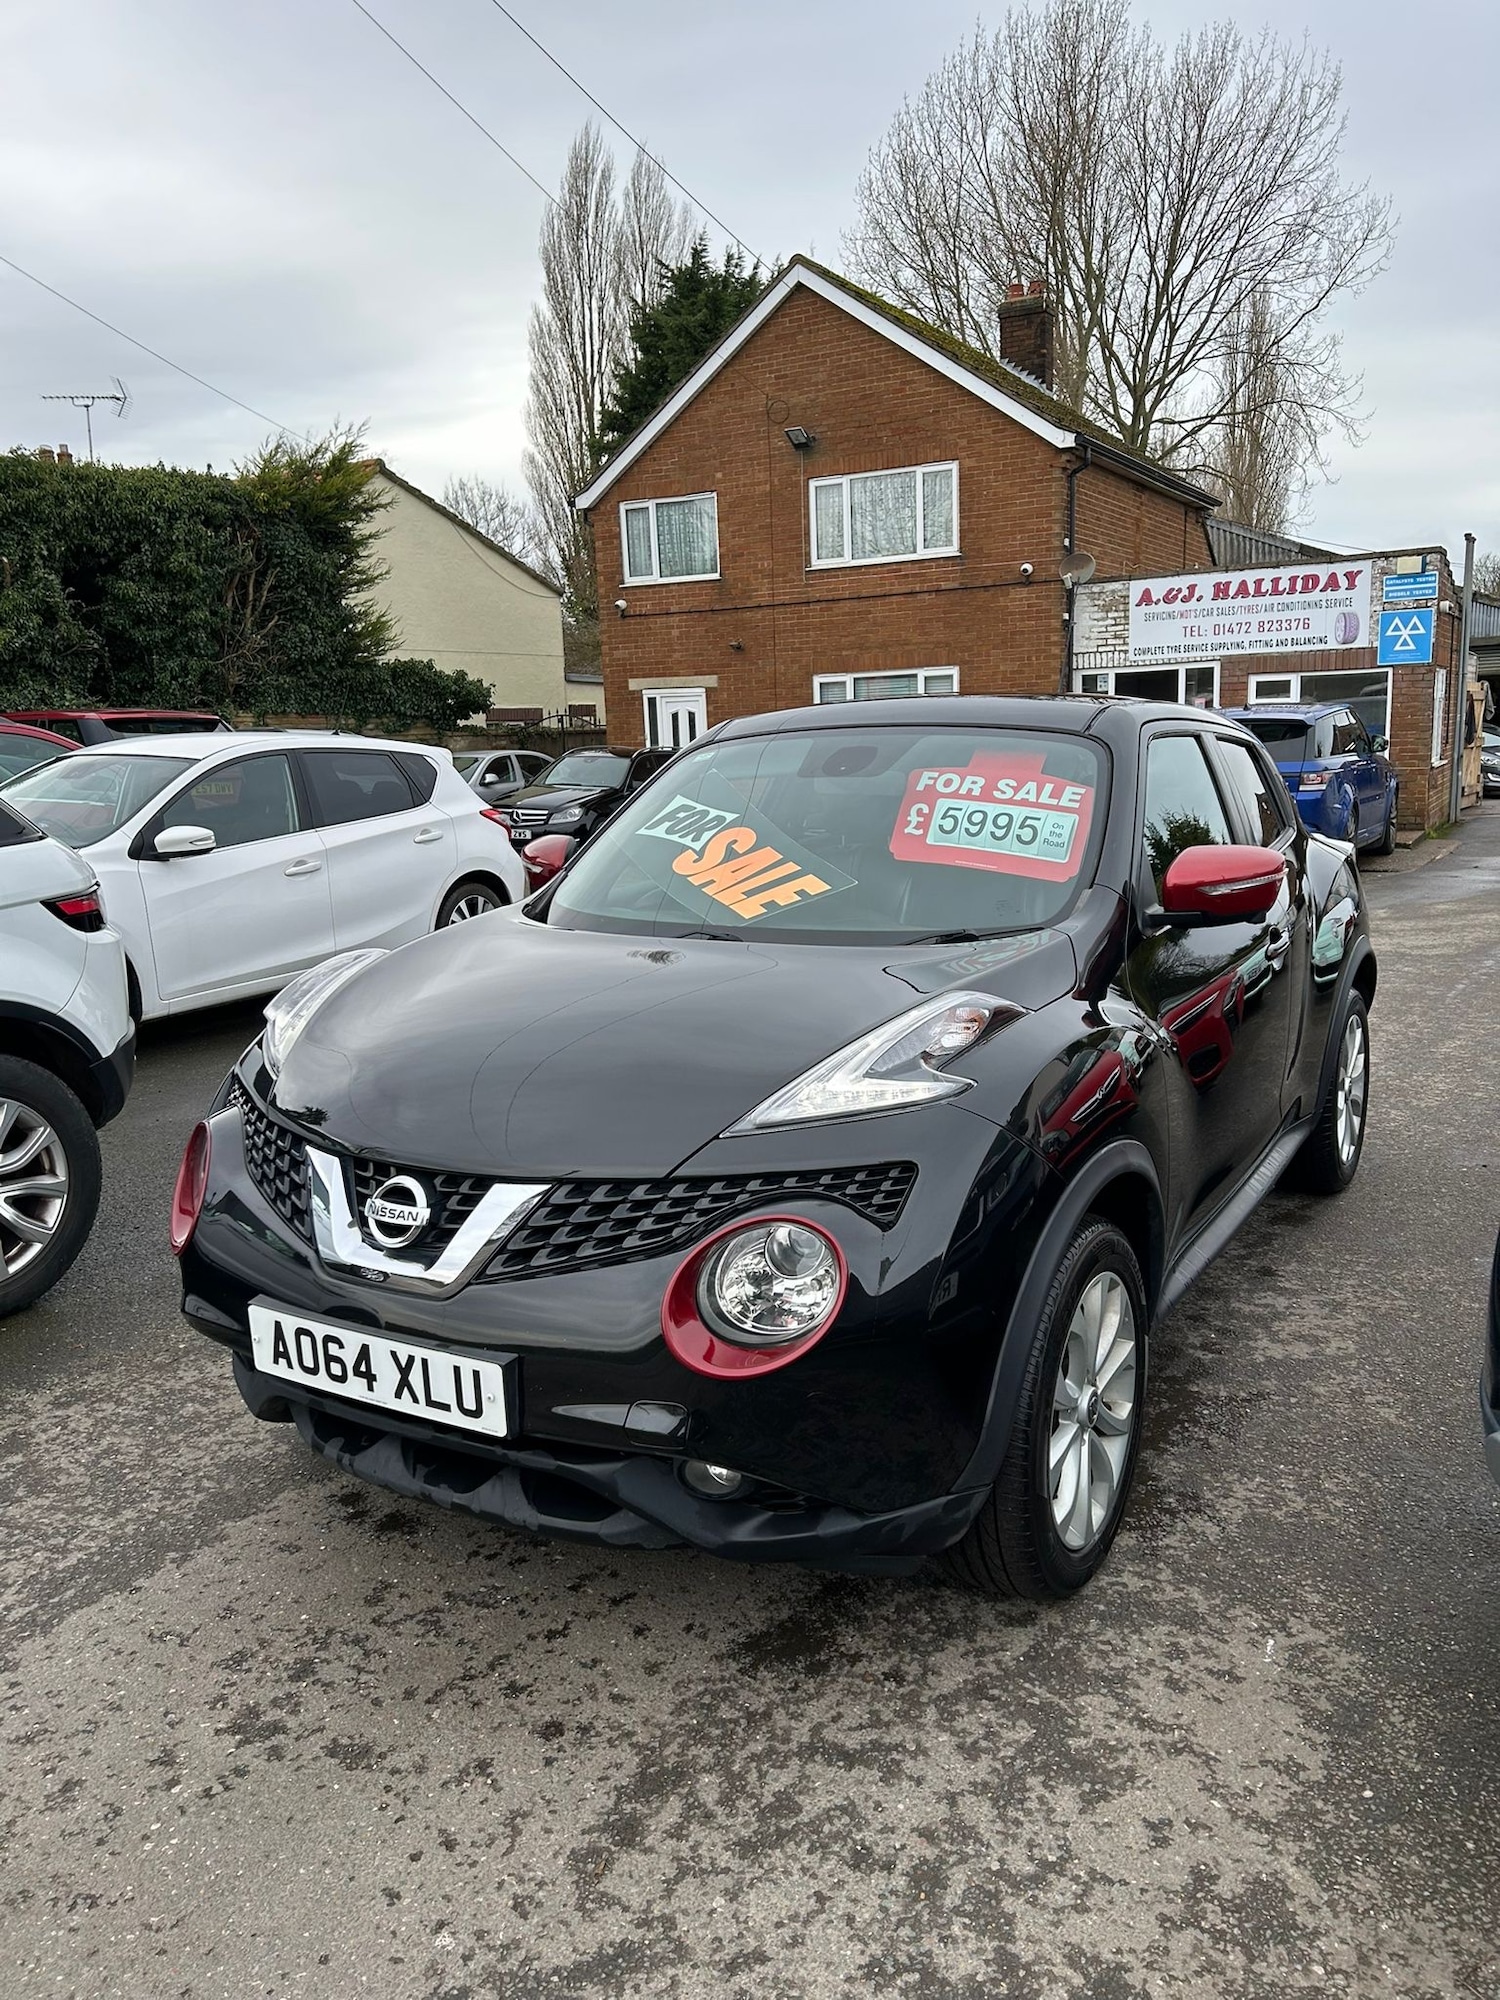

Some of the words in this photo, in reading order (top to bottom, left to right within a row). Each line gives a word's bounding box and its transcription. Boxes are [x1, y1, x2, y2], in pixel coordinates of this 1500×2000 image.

[1211, 570, 1363, 601] HALLIDAY
[1276, 599, 1323, 612] CONDITIONING
[1324, 597, 1353, 609] SERVICE
[1182, 625, 1208, 638] TEL:
[1213, 621, 1251, 636] 01472
[1258, 617, 1311, 633] 823376
[1133, 645, 1165, 656] COMPLETE
[1166, 644, 1182, 654] TYRE
[1183, 642, 1209, 653] SERVICE
[1210, 640, 1247, 651] SUPPLYING,
[1248, 639, 1274, 649] FITTING
[1275, 638, 1289, 647] AND
[1290, 635, 1328, 647] BALANCING
[916, 771, 985, 796] FOR
[992, 778, 1086, 809] SALE
[644, 803, 727, 843] FOR
[938, 806, 1041, 846] 5995
[1052, 822, 1065, 831] On
[1042, 838, 1065, 849] Road
[1050, 830, 1063, 839] the
[671, 826, 832, 920] SALE
[367, 1200, 419, 1222] NISSAN
[272, 1319, 377, 1393] AO64
[390, 1349, 484, 1419] XLU
